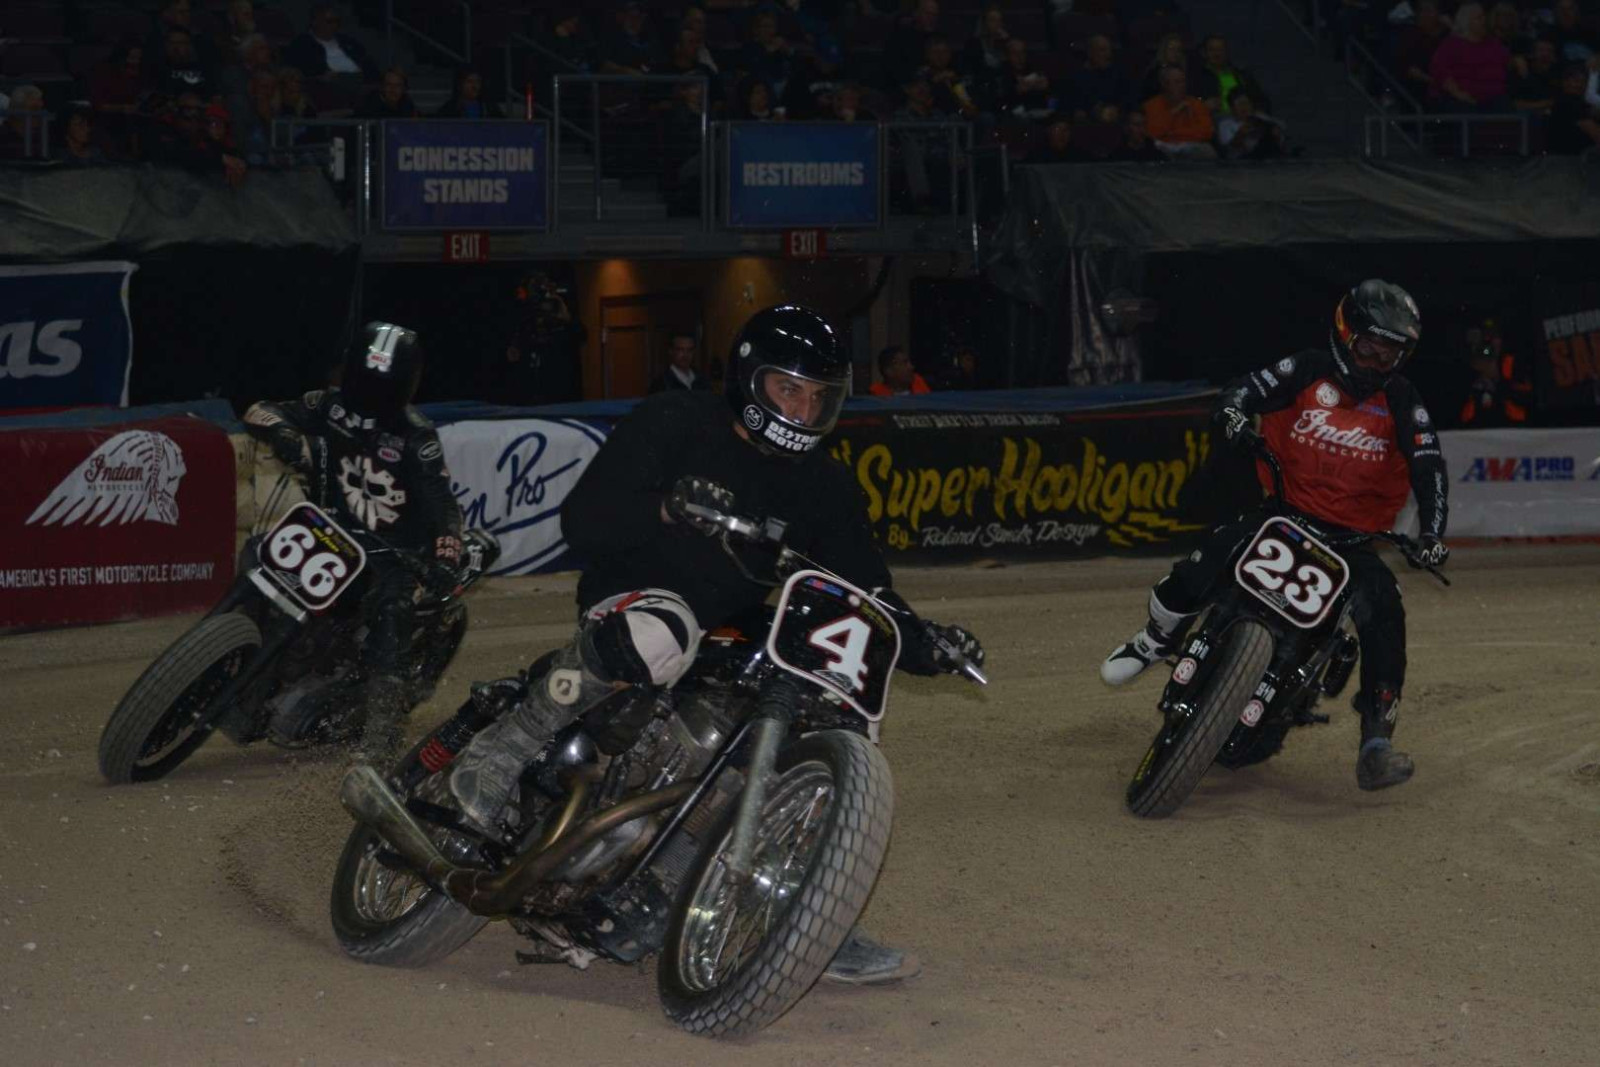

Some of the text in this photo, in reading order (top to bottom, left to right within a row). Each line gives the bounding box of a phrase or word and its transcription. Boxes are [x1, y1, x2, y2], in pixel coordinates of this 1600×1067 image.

[398, 147, 534, 172] CONCESSION
[743, 161, 864, 187] RESTROOMS
[423, 178, 509, 204] STANDS
[450, 233, 481, 261] EXIT
[789, 229, 819, 256] EXIT
[1293, 409, 1390, 454] Indian
[84, 454, 144, 484] Indian
[497, 432, 582, 516] Pro
[1460, 458, 1574, 481] AMA PRO
[887, 519, 1101, 551] By Roland Sands Design
[0, 562, 215, 589] AMERICA'S FIRST MOTORCYCLE COMPANY
[269, 523, 348, 599] 66
[1242, 537, 1334, 616] 23
[808, 614, 873, 693] 4
